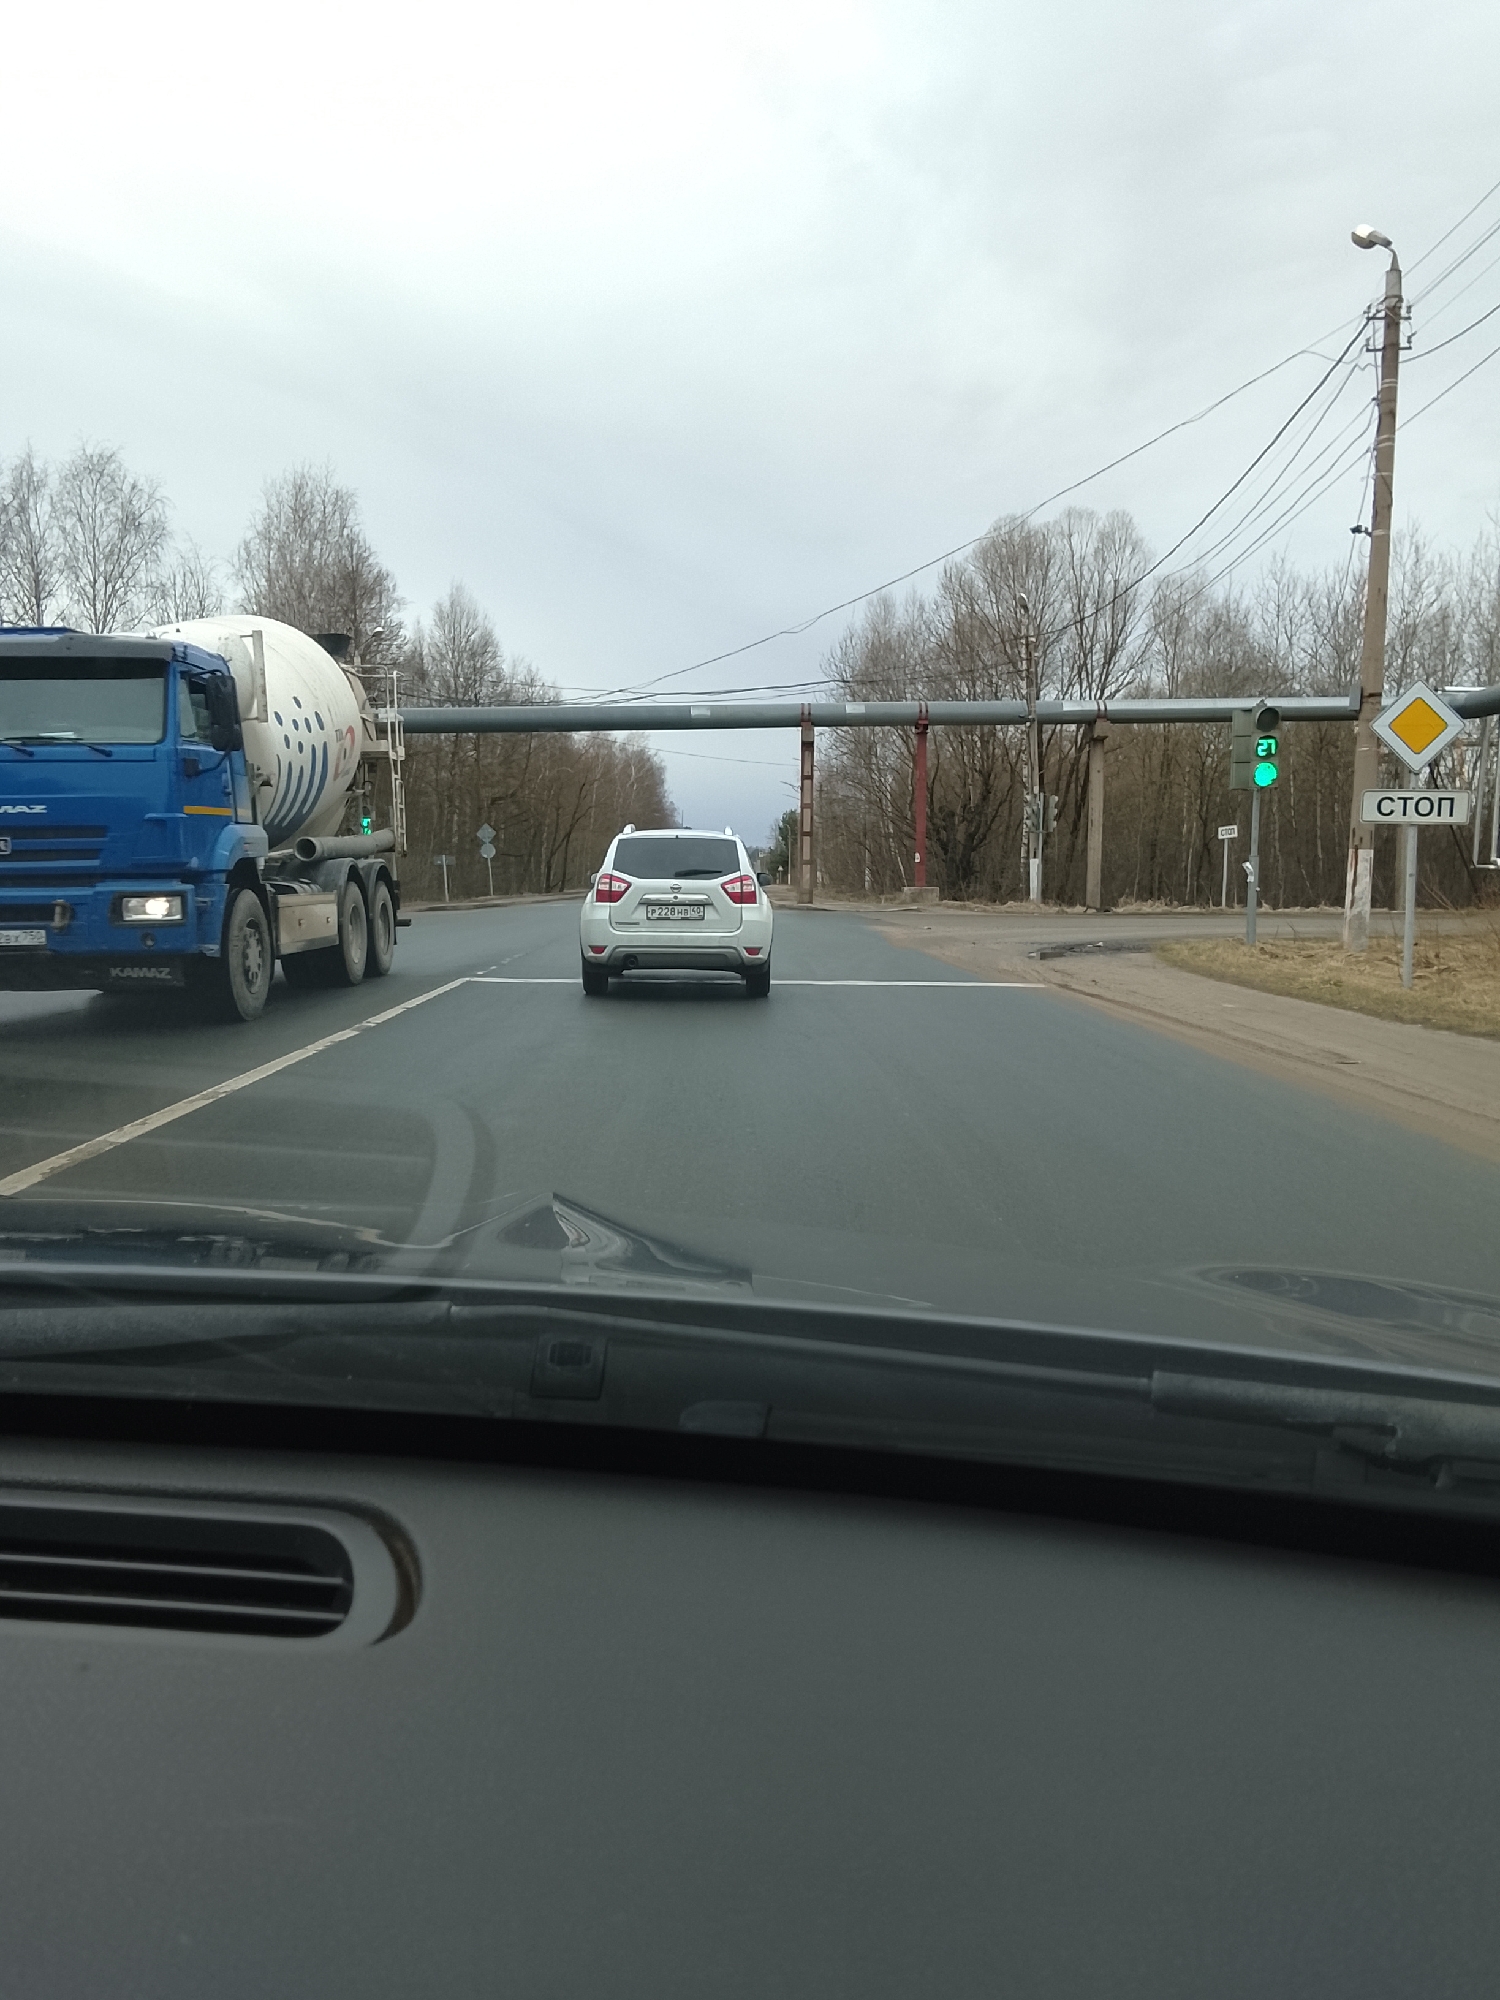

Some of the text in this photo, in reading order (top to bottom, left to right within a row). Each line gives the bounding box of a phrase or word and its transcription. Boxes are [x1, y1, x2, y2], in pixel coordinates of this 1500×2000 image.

[1257, 739, 1276, 756] 27
[1376, 796, 1456, 818] СТОП
[1220, 827, 1236, 837] СТОП
[109, 966, 173, 980] KAMAZ
